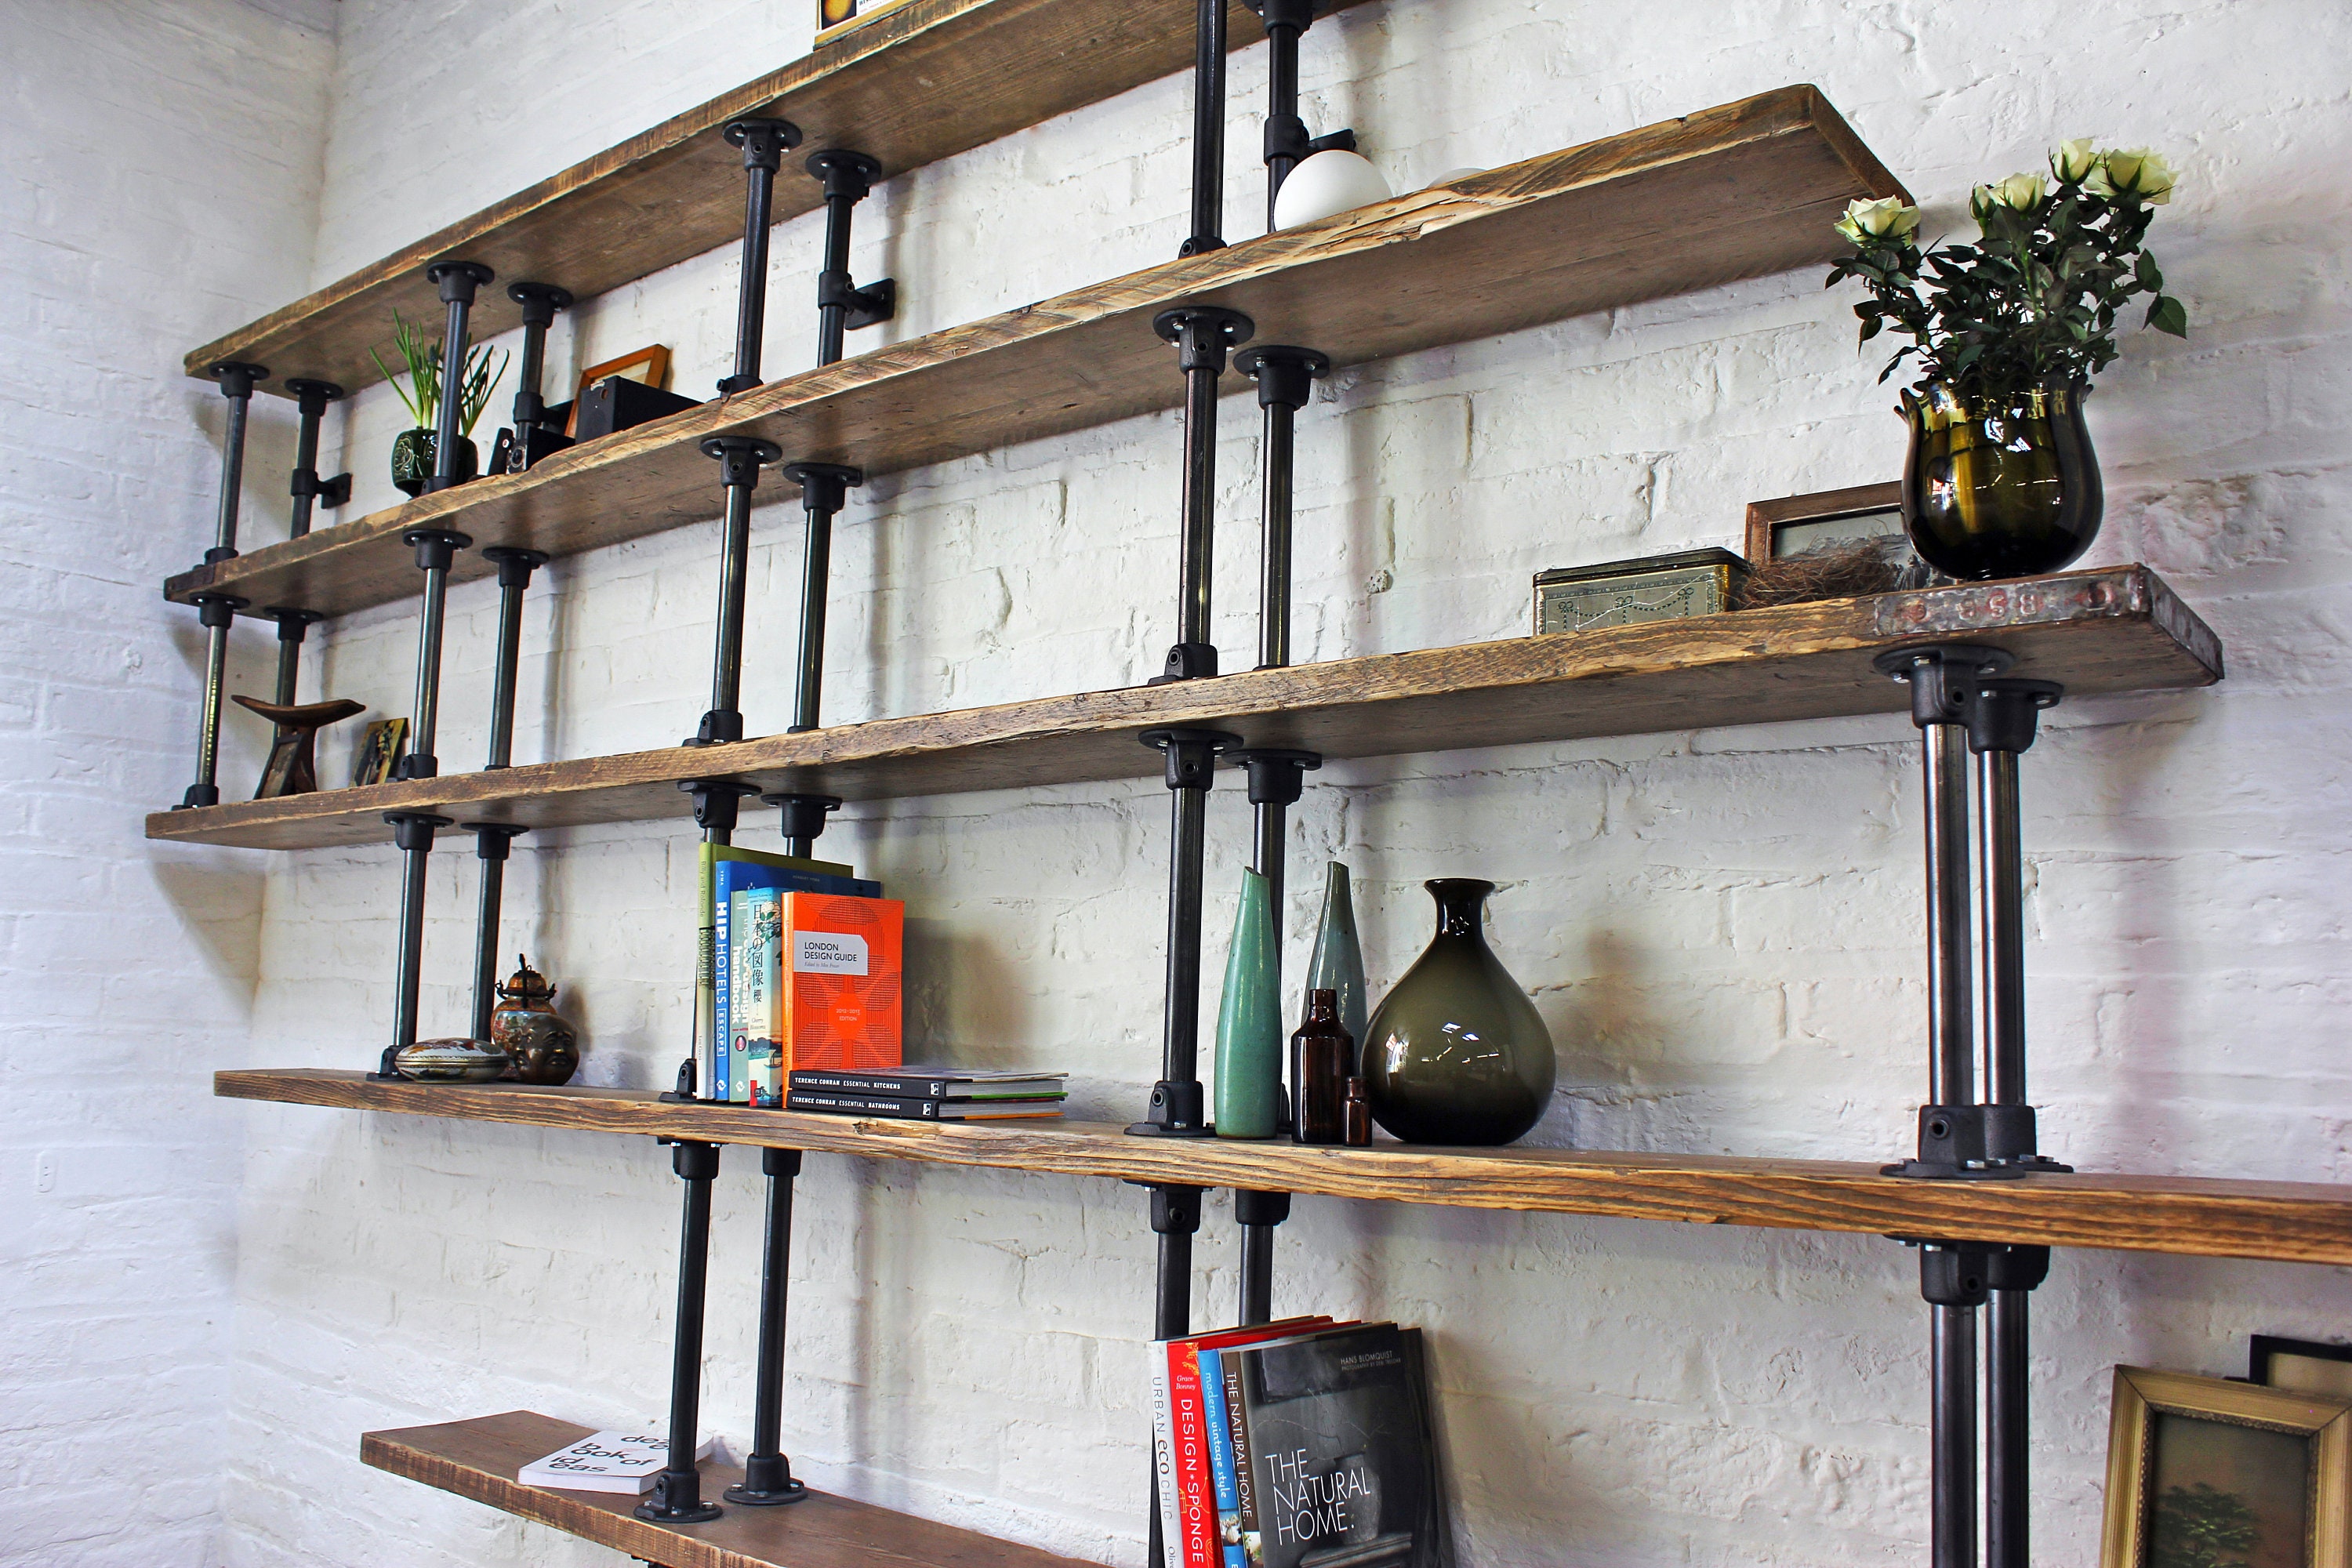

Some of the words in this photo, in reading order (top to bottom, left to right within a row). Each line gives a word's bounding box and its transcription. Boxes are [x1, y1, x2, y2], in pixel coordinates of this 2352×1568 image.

[717, 902, 728, 940] HIP
[804, 942, 839, 951] LONDON
[804, 951, 833, 960] DESIGN
[834, 953, 858, 962] GUIDE
[717, 943, 728, 1004] HOTELS
[732, 946, 743, 1025] handbook
[843, 1080, 870, 1088] ESSENTIAL
[839, 1099, 865, 1108] ESSENTIAL
[868, 1102, 900, 1110] BATHROOMS
[1341, 1355, 1358, 1365] HANS
[1358, 1350, 1392, 1363] BLOMQUIST
[1205, 1372, 1218, 1418] modern
[1226, 1371, 1239, 1398] THE
[1152, 1377, 1166, 1432] URBAN
[1211, 1421, 1223, 1468] vintage
[1229, 1403, 1246, 1467] NATURAL
[1157, 1439, 1170, 1475] eco
[1265, 1448, 1309, 1485] THE
[1160, 1479, 1173, 1520] CHIC
[1218, 1471, 1231, 1499] style
[1272, 1467, 1371, 1515] NATURAL
